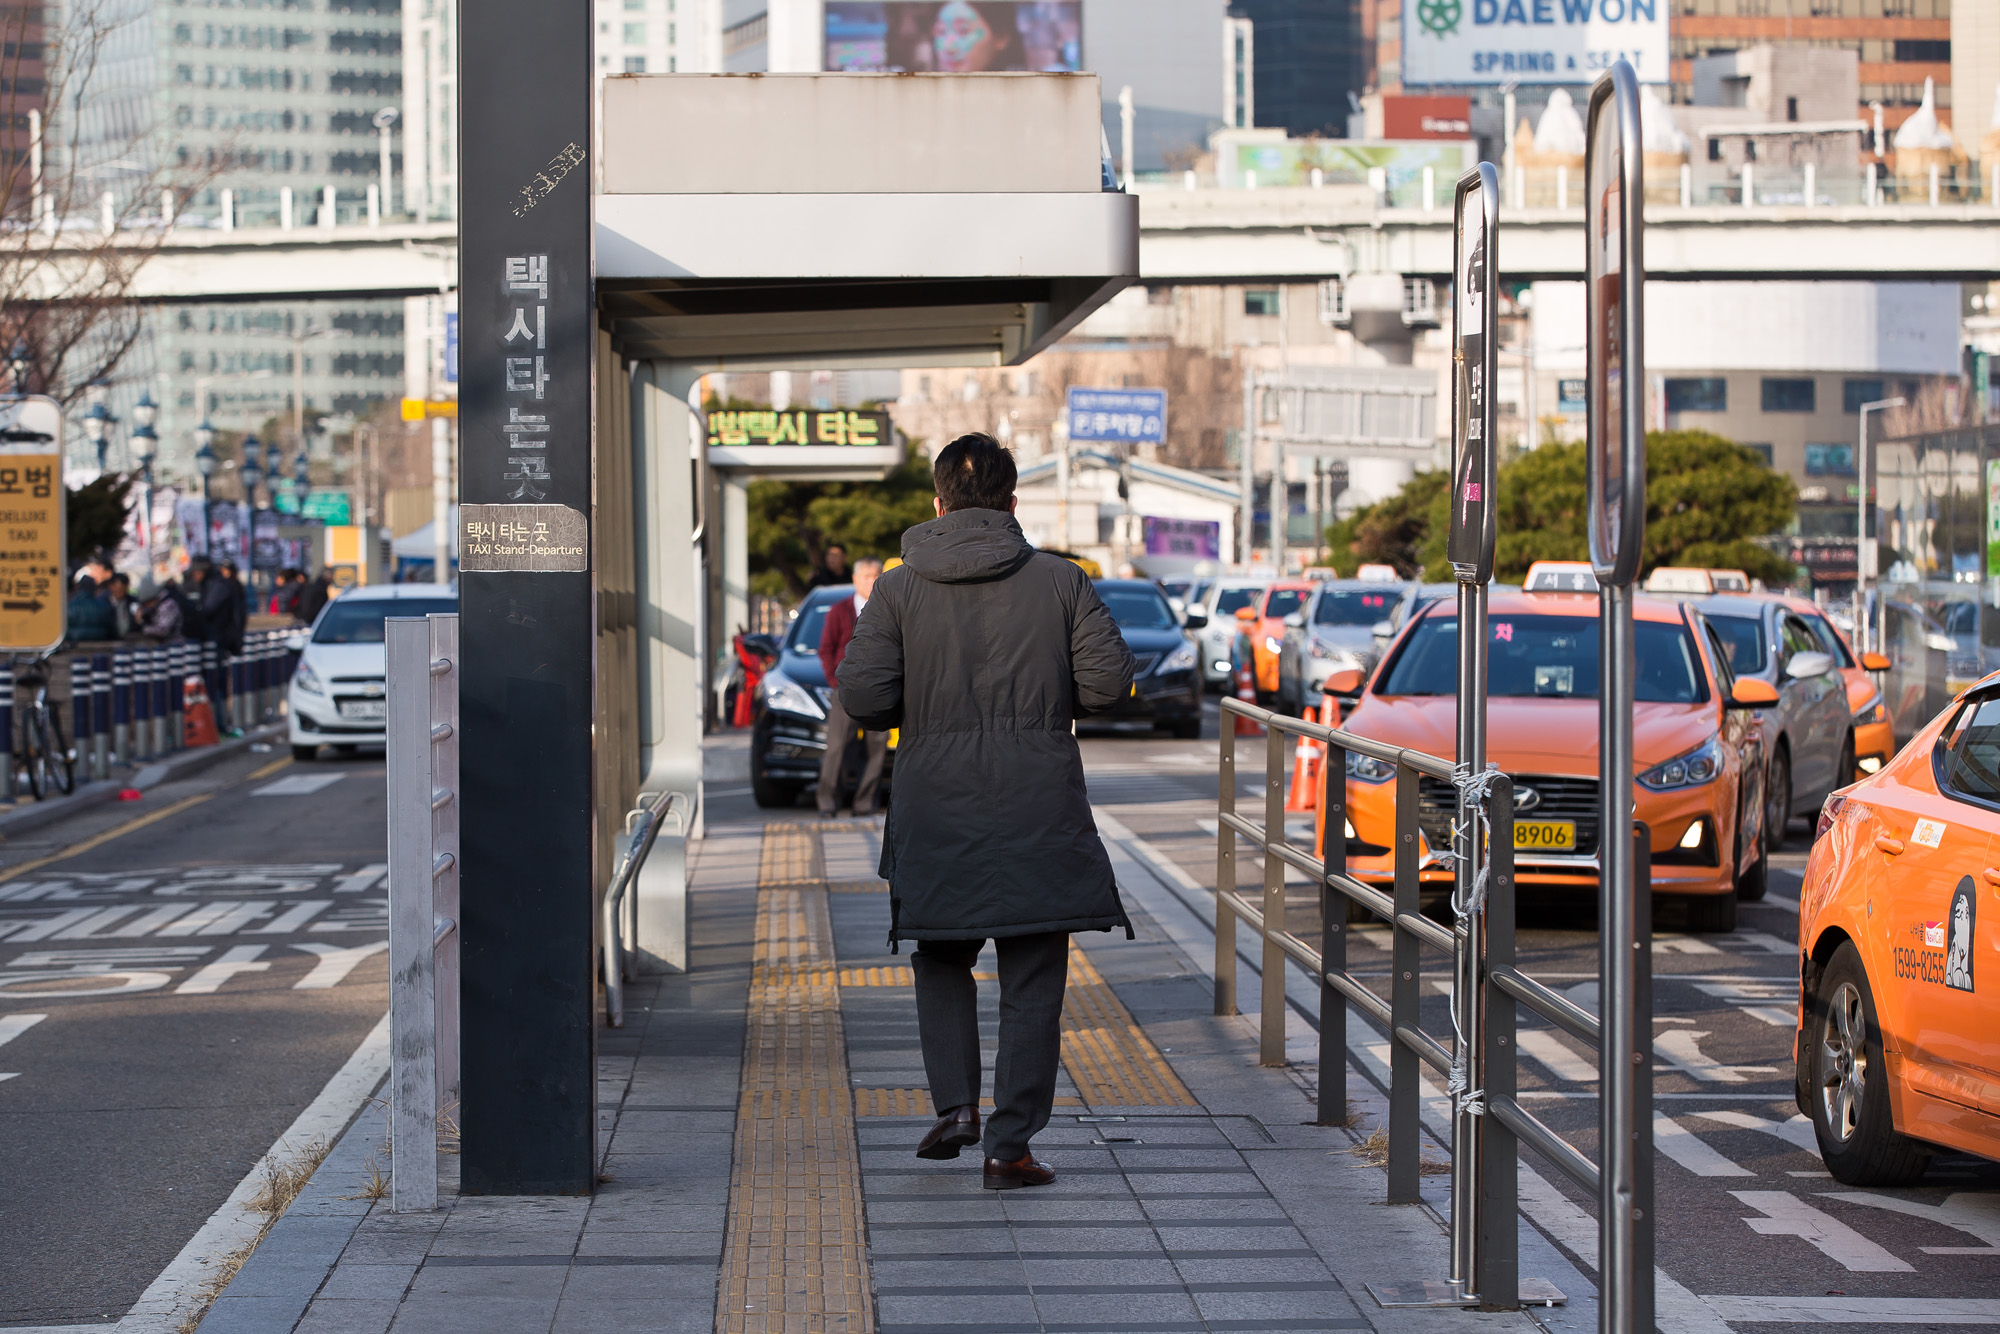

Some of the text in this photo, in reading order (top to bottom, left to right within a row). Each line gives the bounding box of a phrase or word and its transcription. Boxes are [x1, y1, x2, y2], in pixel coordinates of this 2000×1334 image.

[1473, 0, 1656, 25] DAEWON
[1472, 51, 1555, 72] SPRING
[817, 411, 879, 446] 타는
[8, 529, 38, 541] TAXI
[467, 522, 549, 541] 택시 타는 곳
[468, 544, 583, 556] TAXI Stand-Departure
[1495, 623, 1513, 642] 차
[1516, 825, 1567, 845] 8906
[1893, 946, 1945, 985] 1599-8255
